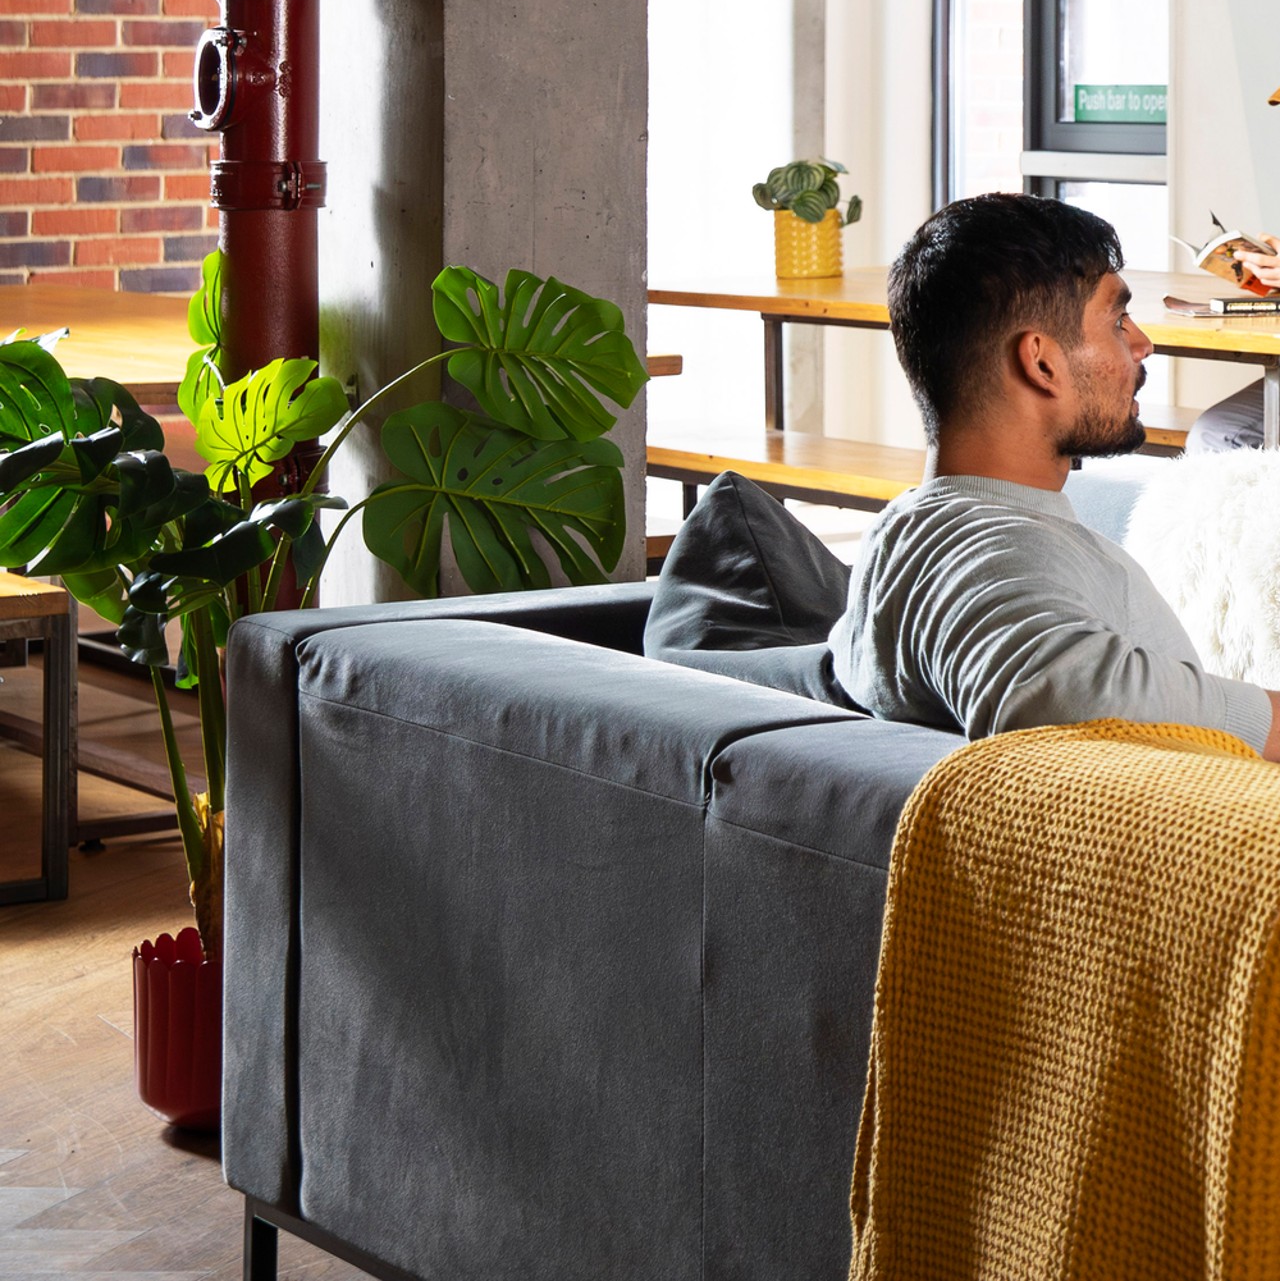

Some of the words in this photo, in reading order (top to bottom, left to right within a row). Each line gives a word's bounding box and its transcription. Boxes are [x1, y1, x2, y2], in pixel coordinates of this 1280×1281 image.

[1079, 90, 1106, 111] Push
[1107, 90, 1126, 111] bar
[1128, 91, 1141, 111] to
